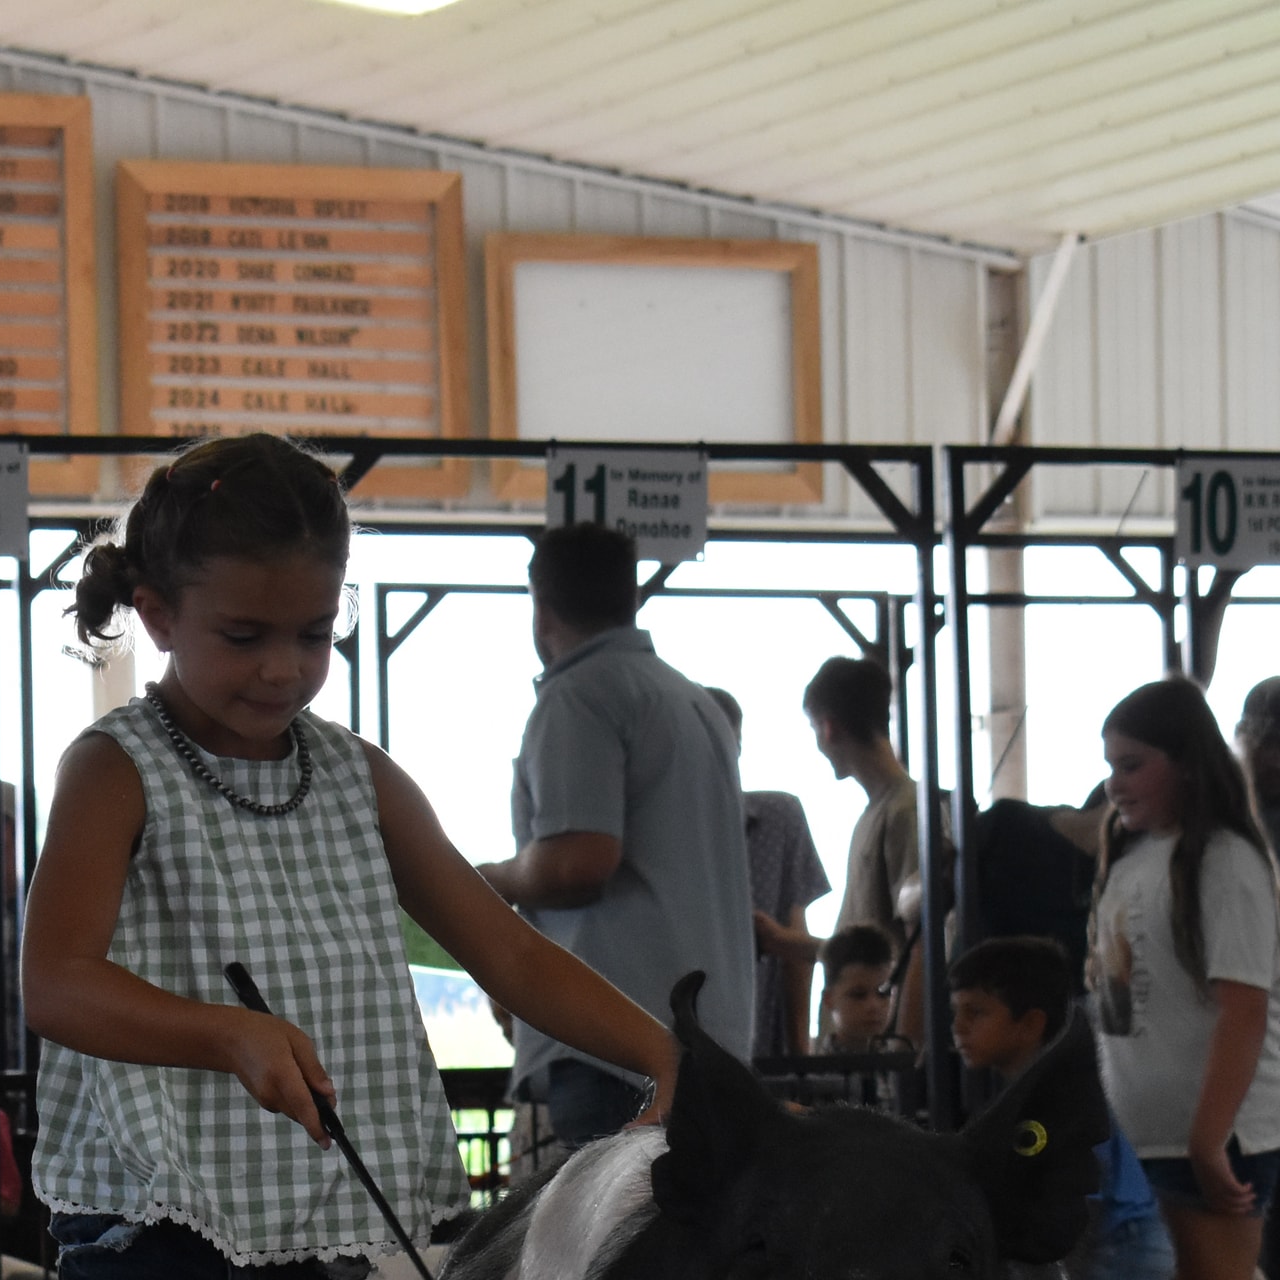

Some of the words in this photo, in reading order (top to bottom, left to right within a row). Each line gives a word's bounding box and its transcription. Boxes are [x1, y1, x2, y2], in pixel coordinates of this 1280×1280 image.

[167, 259, 220, 277] 2020
[166, 292, 213, 310] 2021
[168, 324, 220, 342] 2022
[170, 356, 221, 374] 2023
[241, 358, 286, 377] CALE
[307, 361, 351, 380] HALL
[169, 389, 220, 408] 2024
[243, 392, 288, 411] CALE
[6, 461, 20, 473] of
[610, 470, 623, 481] In
[628, 469, 682, 486] Memory
[687, 470, 701, 482] of
[554, 463, 606, 526] 11
[628, 489, 680, 509] Ranae
[1182, 470, 1238, 556] 10
[617, 518, 692, 539] Donohoe
[1248, 516, 1263, 532] 1st
